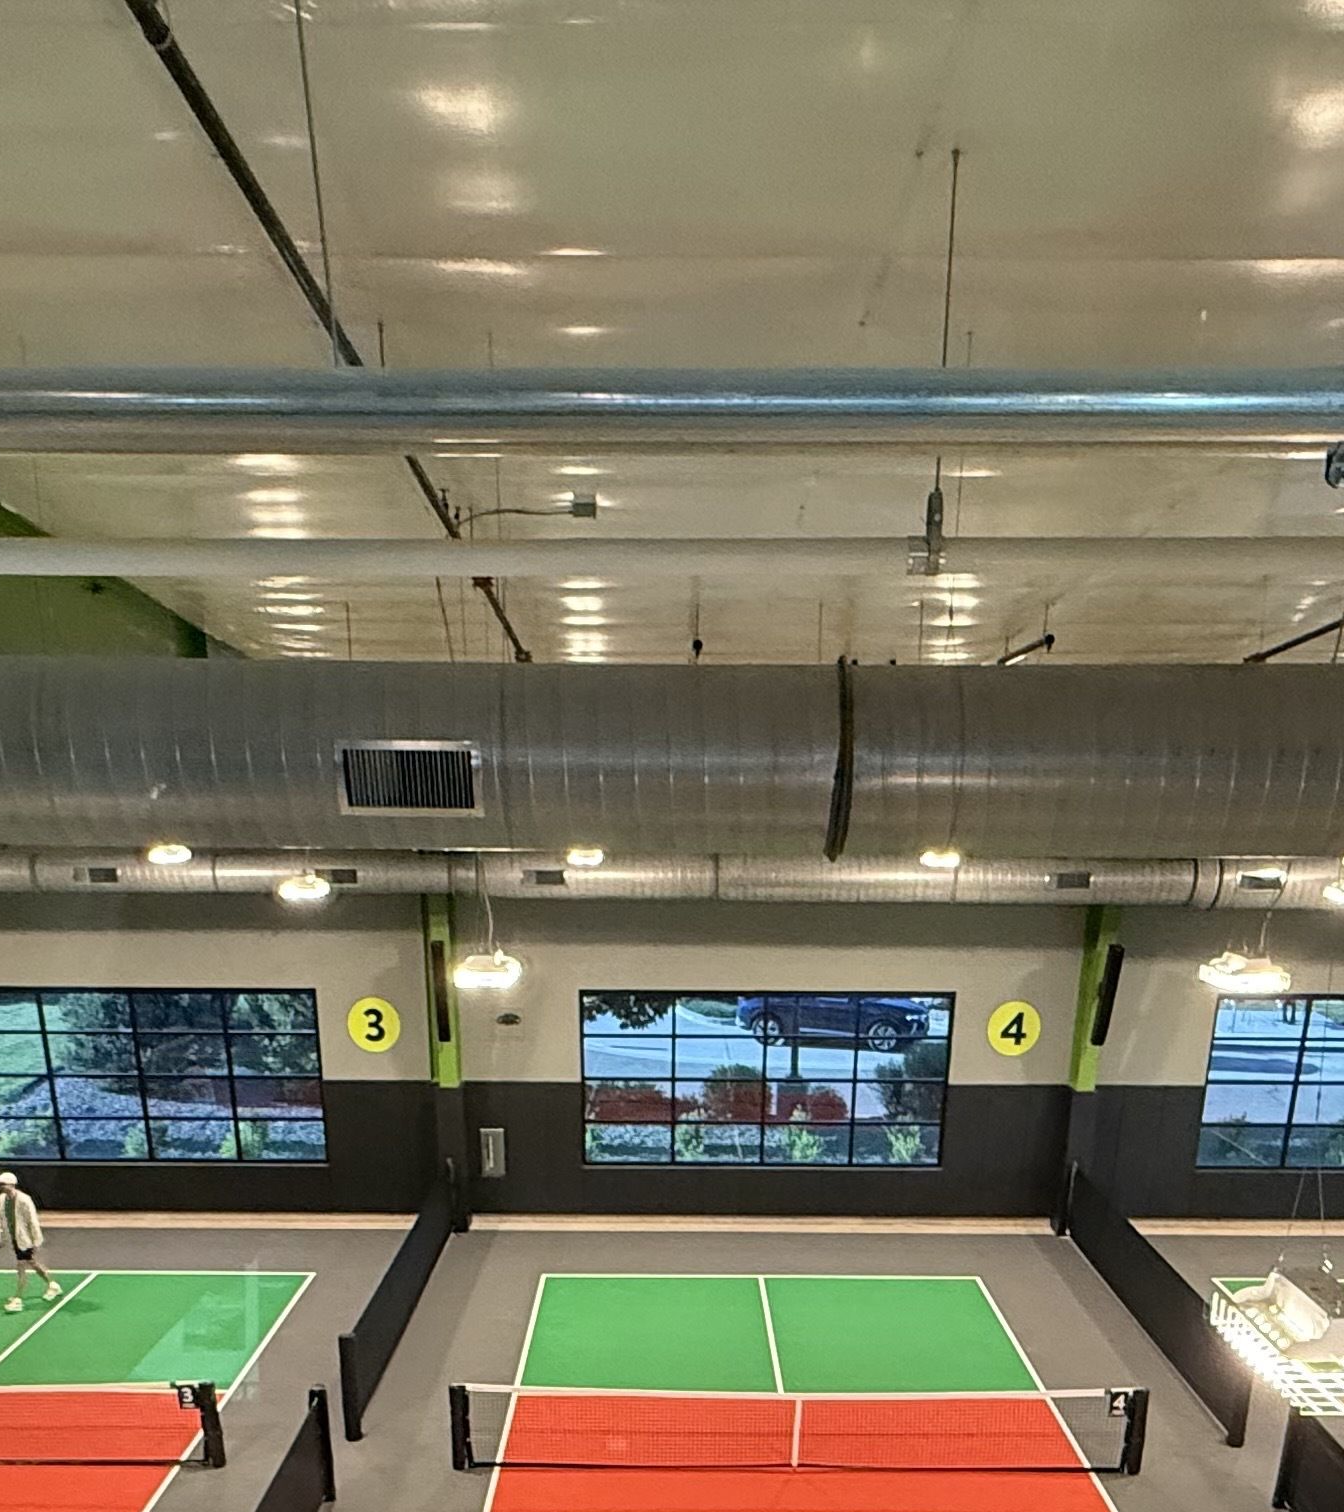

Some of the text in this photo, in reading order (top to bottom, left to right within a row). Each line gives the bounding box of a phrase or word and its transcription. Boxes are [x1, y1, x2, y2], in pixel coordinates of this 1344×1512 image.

[363, 1008, 386, 1042] 3
[1000, 1011, 1027, 1046] 4
[180, 1386, 194, 1403] 3
[1112, 1393, 1126, 1410] 4
